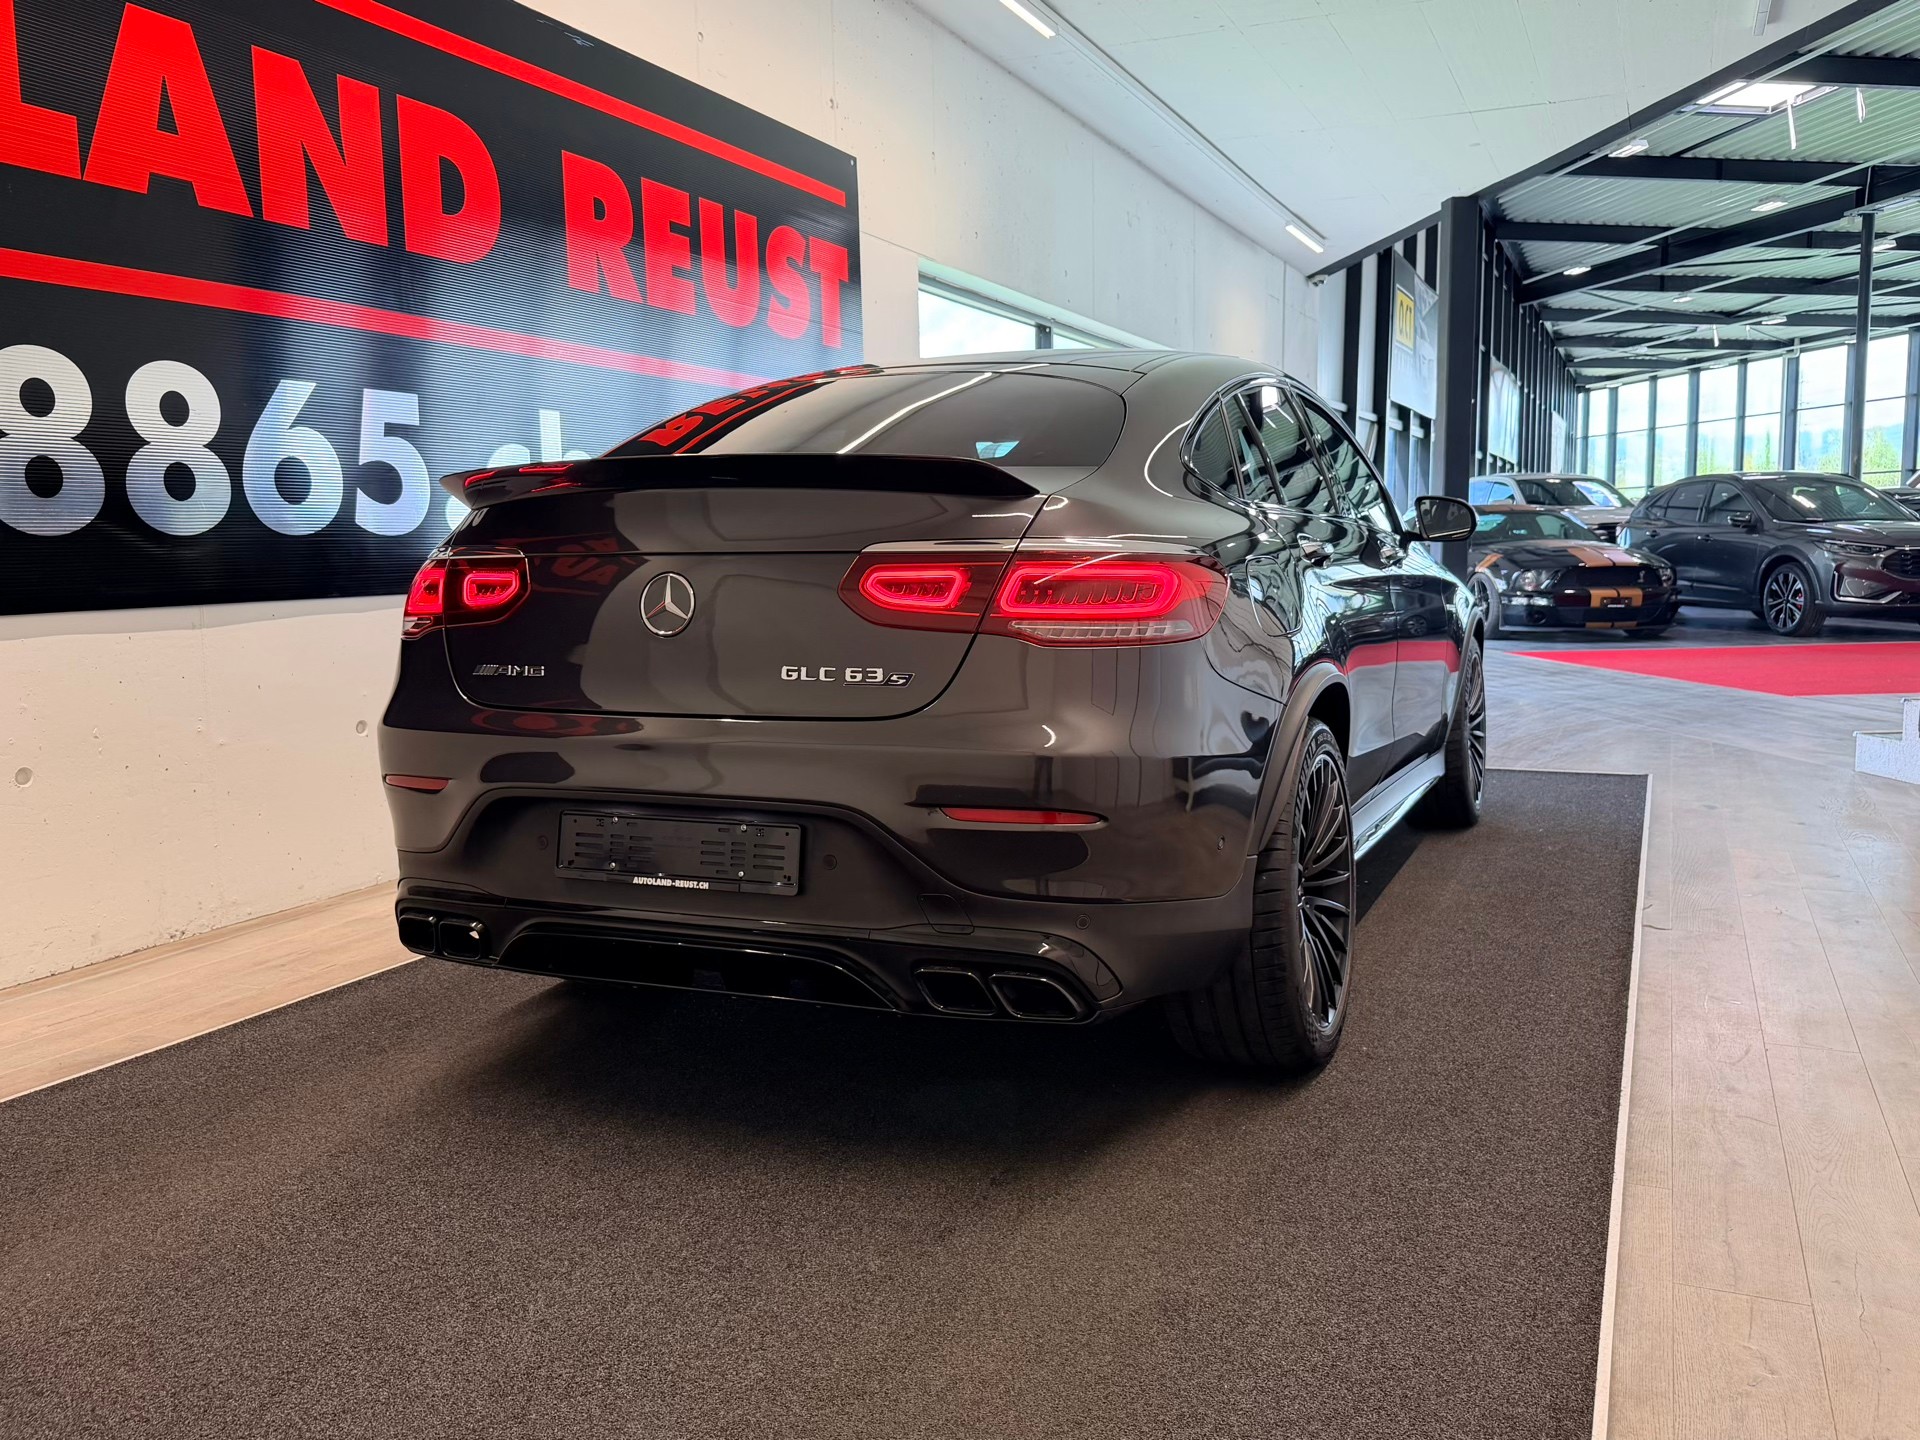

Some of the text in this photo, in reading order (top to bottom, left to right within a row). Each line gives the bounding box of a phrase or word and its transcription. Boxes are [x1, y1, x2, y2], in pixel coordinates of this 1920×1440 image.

[562, 150, 849, 349] REUST
[498, 664, 545, 677] AMG
[780, 665, 837, 682] GLC
[844, 667, 884, 682] 63
[632, 876, 709, 890] AUTOLAND-REUST.CH
